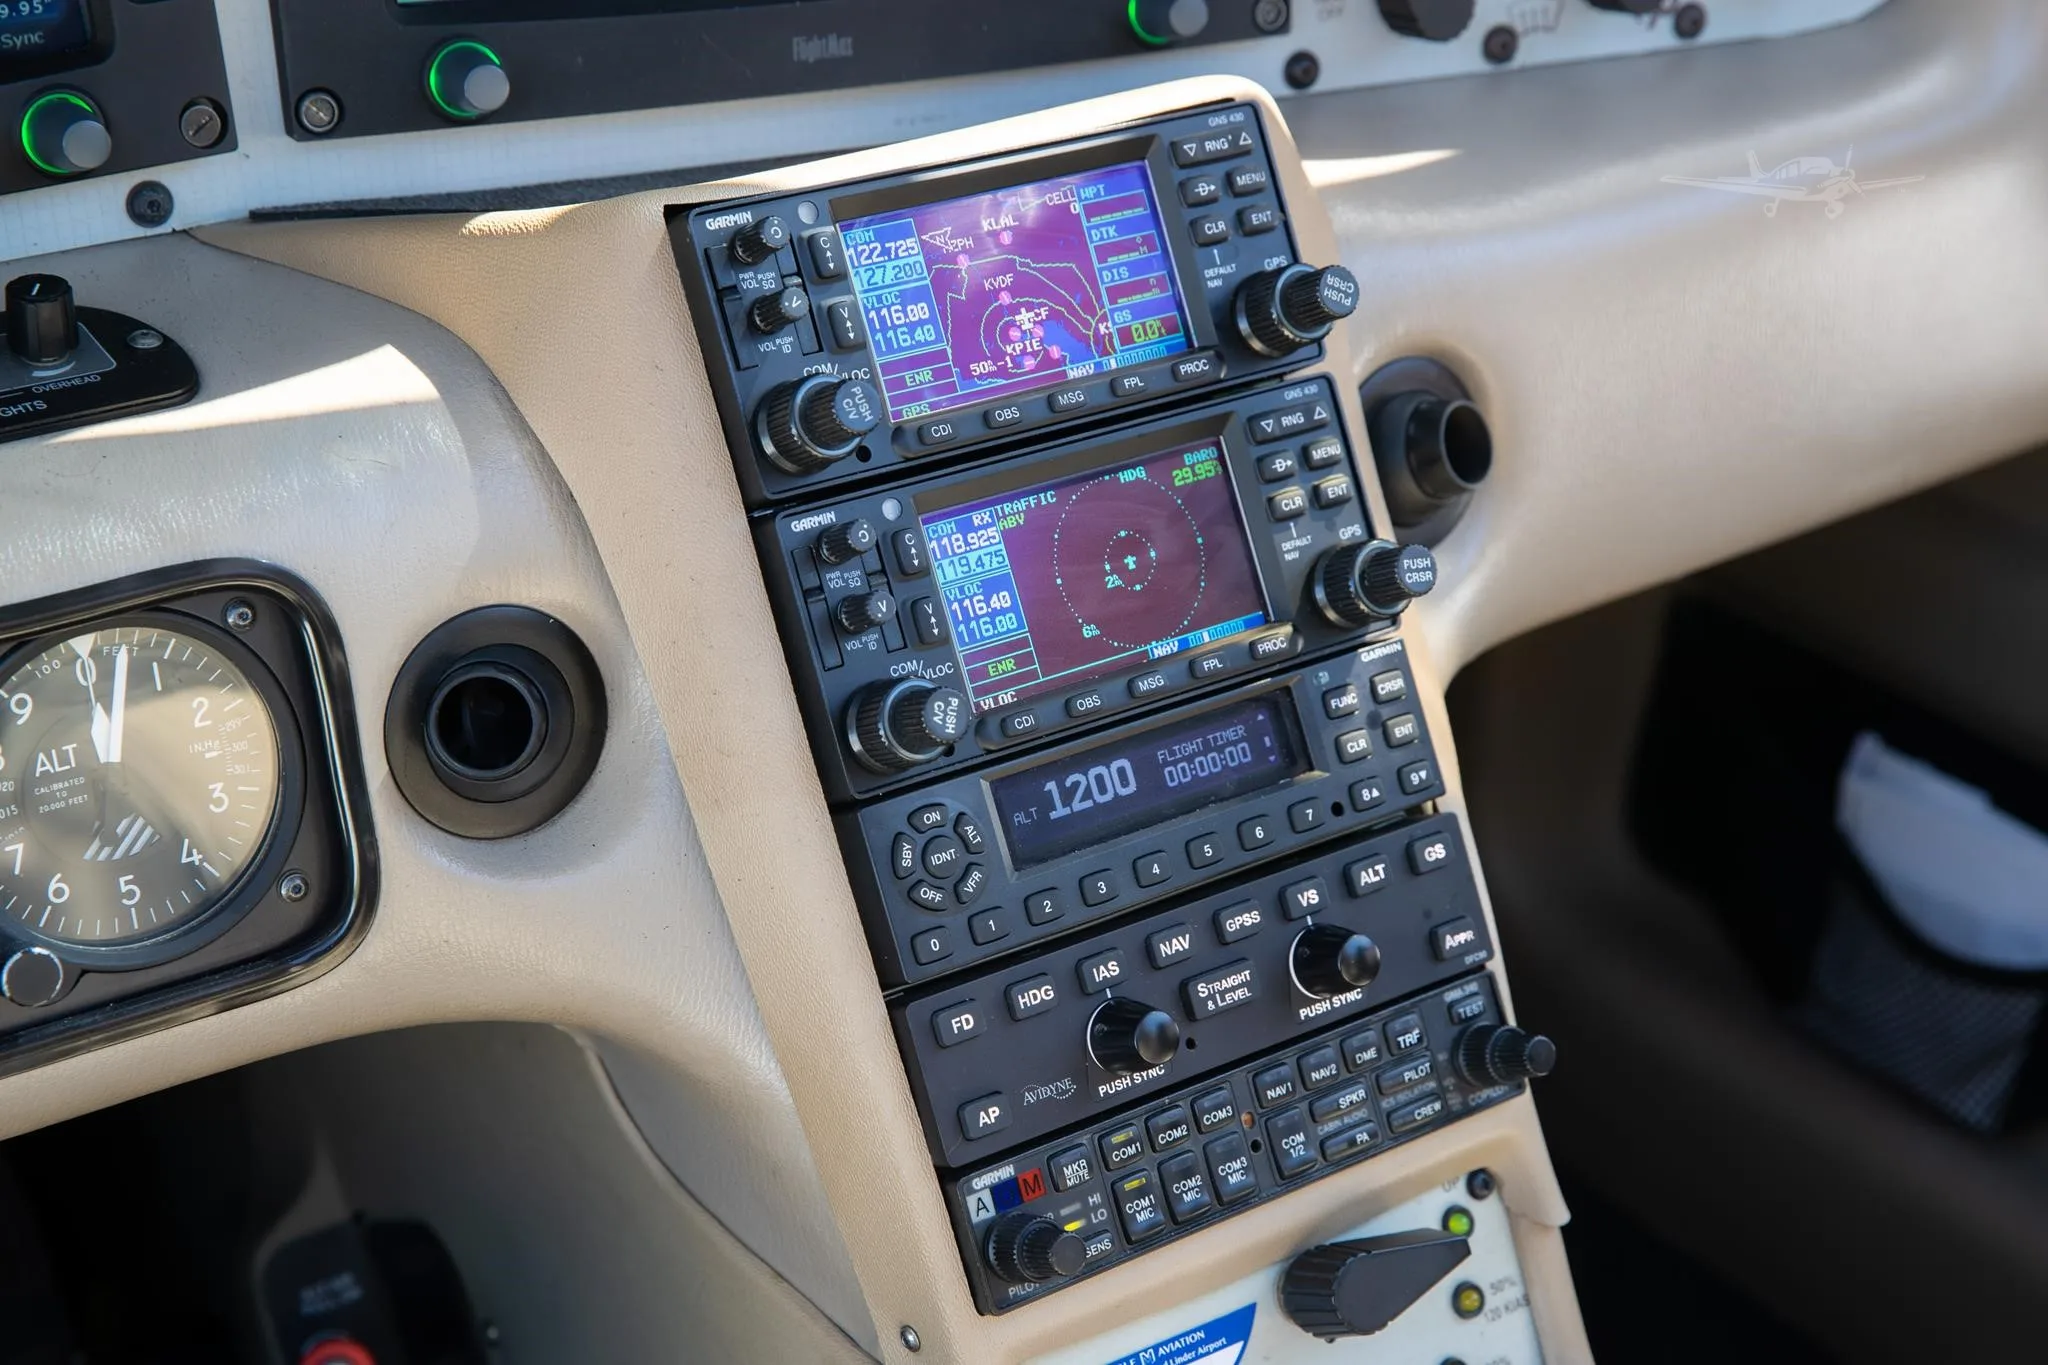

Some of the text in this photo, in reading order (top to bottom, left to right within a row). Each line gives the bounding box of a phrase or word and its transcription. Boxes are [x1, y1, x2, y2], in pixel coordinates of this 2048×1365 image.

[0, 31, 45, 51] Sync
[1204, 137, 1228, 152] RNG
[1236, 172, 1266, 186] MENU
[706, 211, 752, 230] GARMIN
[982, 214, 1019, 232] KLAL
[1204, 220, 1226, 235] CLR
[1251, 211, 1272, 225] ENT
[846, 230, 874, 245] COM
[1091, 225, 1118, 242] DTK
[847, 238, 918, 266] 122.725
[1204, 264, 1237, 278] DEFAULT
[1264, 256, 1288, 271] GPS
[855, 261, 925, 289] 127.200
[983, 274, 1014, 291] KVDF
[1102, 267, 1129, 283] DIS
[1207, 278, 1223, 288] NAV
[1327, 273, 1355, 293] CRSR
[863, 292, 900, 309] VLOC
[1323, 287, 1352, 306] PUSH
[869, 302, 930, 329] 116.00
[1114, 309, 1132, 323] GS
[875, 325, 936, 352] 116.40
[1006, 337, 1042, 355] KPIE
[1069, 363, 1095, 379] NAV
[1179, 359, 1209, 376] PROC
[32, 374, 101, 394] OVERHEAD
[905, 370, 934, 387] ENR
[1124, 376, 1145, 390] FPL
[851, 386, 873, 421] PUSH
[1058, 390, 1084, 406] MSG
[903, 403, 930, 418] GPS
[995, 406, 1020, 421] OBS
[1281, 413, 1304, 428] RNG
[931, 424, 952, 438] CDI
[1184, 446, 1218, 466] BARO
[1312, 444, 1341, 460] MENU
[1119, 466, 1146, 483] HDG
[1328, 483, 1348, 498] ENT
[994, 490, 1056, 517] TRAFFIC
[1281, 496, 1303, 512] CLR
[790, 511, 836, 532] GARMIN
[972, 511, 992, 527] RX
[1000, 513, 1025, 530] ABV
[928, 521, 957, 539] COM
[1339, 524, 1362, 540] GPS
[930, 527, 1000, 559] 118.925
[1281, 535, 1312, 551] DEFAULT
[937, 549, 1006, 580] 119.475
[1284, 550, 1300, 561] NAV
[1404, 558, 1431, 571] PUSH
[1406, 570, 1433, 583] CRSR
[946, 582, 983, 600] VLOC
[951, 591, 1012, 621] 116.40
[958, 613, 1018, 642] 116.00
[1153, 641, 1179, 659] NAV
[1258, 636, 1287, 655] PROC
[1360, 642, 1403, 663] GARMIN
[988, 658, 1017, 676] ENR
[1203, 658, 1223, 672] FPL
[1139, 675, 1165, 692] MSG
[1378, 678, 1405, 695] CRSR
[10, 692, 33, 725] 9
[980, 691, 1017, 711] VLOC
[1076, 695, 1101, 711] OBS
[1330, 693, 1358, 710] FUNC
[192, 697, 212, 728] 2
[933, 701, 945, 725] C/V
[945, 696, 959, 734] PUSH
[1014, 714, 1035, 730] CDI
[1394, 723, 1414, 739] ENT
[1158, 725, 1247, 765] FLIGHT TIMER
[1346, 738, 1368, 753] CLR
[35, 743, 78, 778] ALT
[1163, 742, 1252, 789] 00:00:00
[34, 776, 85, 796] CALIBRATED
[56, 790, 68, 799] TO
[1043, 758, 1137, 821] 1200
[68, 794, 89, 807] FEET
[208, 782, 229, 813] 3
[923, 811, 941, 825] ON
[1013, 807, 1038, 826] ALT
[964, 824, 982, 845] ALT
[4, 843, 25, 875] 7
[181, 839, 203, 867] 4
[902, 842, 912, 868] SBY
[931, 848, 957, 866] IDNT
[1424, 842, 1447, 862] GS
[963, 871, 983, 893] VFR
[1359, 863, 1387, 887] ALT
[47, 873, 70, 904] 6
[118, 875, 141, 905] 5
[920, 887, 943, 903] OFF
[1297, 888, 1320, 908] VS
[1225, 910, 1261, 932] GPSS
[1159, 934, 1190, 957] NAV
[1092, 960, 1120, 983] IAS
[1197, 970, 1252, 999] STRAIGHT
[1018, 985, 1055, 1009] HDG
[1216, 988, 1252, 1008] LEVEL
[1299, 988, 1363, 1021] PUSH SYNC
[1457, 1000, 1484, 1019] TEST
[951, 1014, 975, 1034] FD
[1397, 1029, 1421, 1050] TRF
[1355, 1047, 1378, 1064] DME
[1098, 1064, 1165, 1098] PUSH SYNC
[1311, 1063, 1337, 1082] NAV2
[1404, 1062, 1432, 1083] PILOT
[1023, 1077, 1075, 1106] AVIDYNE
[1266, 1082, 1293, 1100] NAV1
[1338, 1088, 1366, 1110] SPKR
[978, 1105, 1001, 1128] AP
[1203, 1105, 1233, 1126] COM3
[1343, 1108, 1368, 1125] AUDIO
[1414, 1101, 1442, 1121] CREW
[1158, 1124, 1188, 1145] COM2
[1282, 1132, 1306, 1149] COM
[1356, 1131, 1370, 1145] PA
[1112, 1142, 1142, 1162] COM1
[1289, 1145, 1305, 1158] 1/2
[1063, 1158, 1088, 1177] MKR
[1218, 1156, 1248, 1176] COM3
[972, 1164, 1015, 1190] GARMIN
[1023, 1173, 1042, 1197] M
[1066, 1172, 1090, 1188] MUTE
[1172, 1174, 1203, 1195] COM2
[1228, 1169, 1247, 1185] MIC
[1088, 1192, 1101, 1207] HI
[1126, 1194, 1155, 1214] COM1
[1182, 1187, 1201, 1203] MIC
[976, 1197, 990, 1217] A
[1091, 1209, 1108, 1224] LO
[1135, 1207, 1155, 1224] MIC
[1157, 1330, 1206, 1357] AVIATION
[1197, 1337, 1228, 1357] Airport
